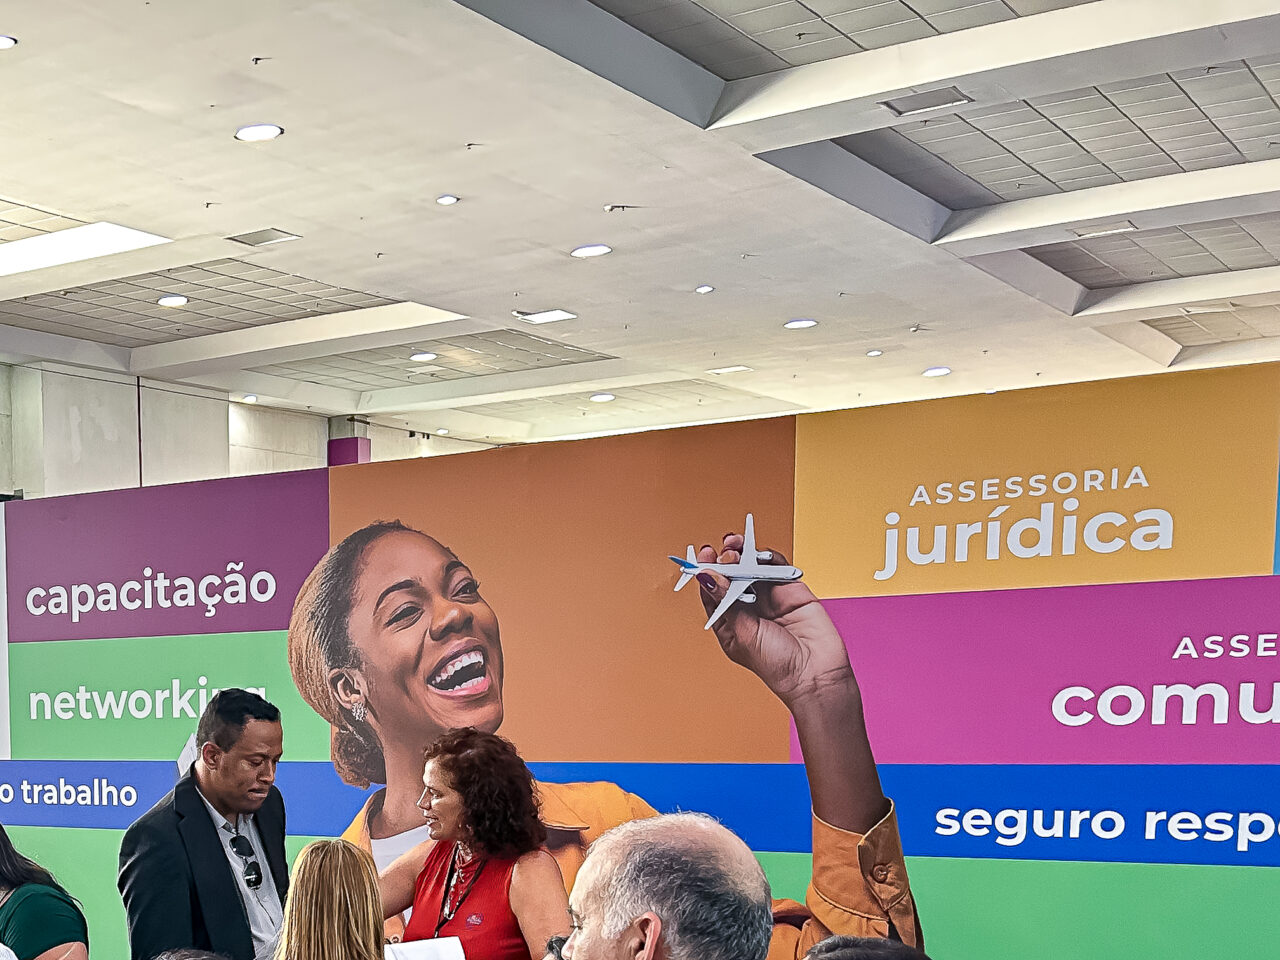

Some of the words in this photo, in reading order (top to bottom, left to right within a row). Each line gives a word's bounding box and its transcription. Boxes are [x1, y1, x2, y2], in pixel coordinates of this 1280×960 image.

[909, 465, 1150, 507] ASSESSORIA
[873, 497, 1174, 581] jurídica
[25, 561, 277, 623] capacitação
[1171, 633, 1278, 659] ASSE
[29, 676, 266, 720] networki
[20, 777, 138, 807] trabalho
[934, 807, 1126, 846] seguro
[1144, 810, 1280, 852] resp
